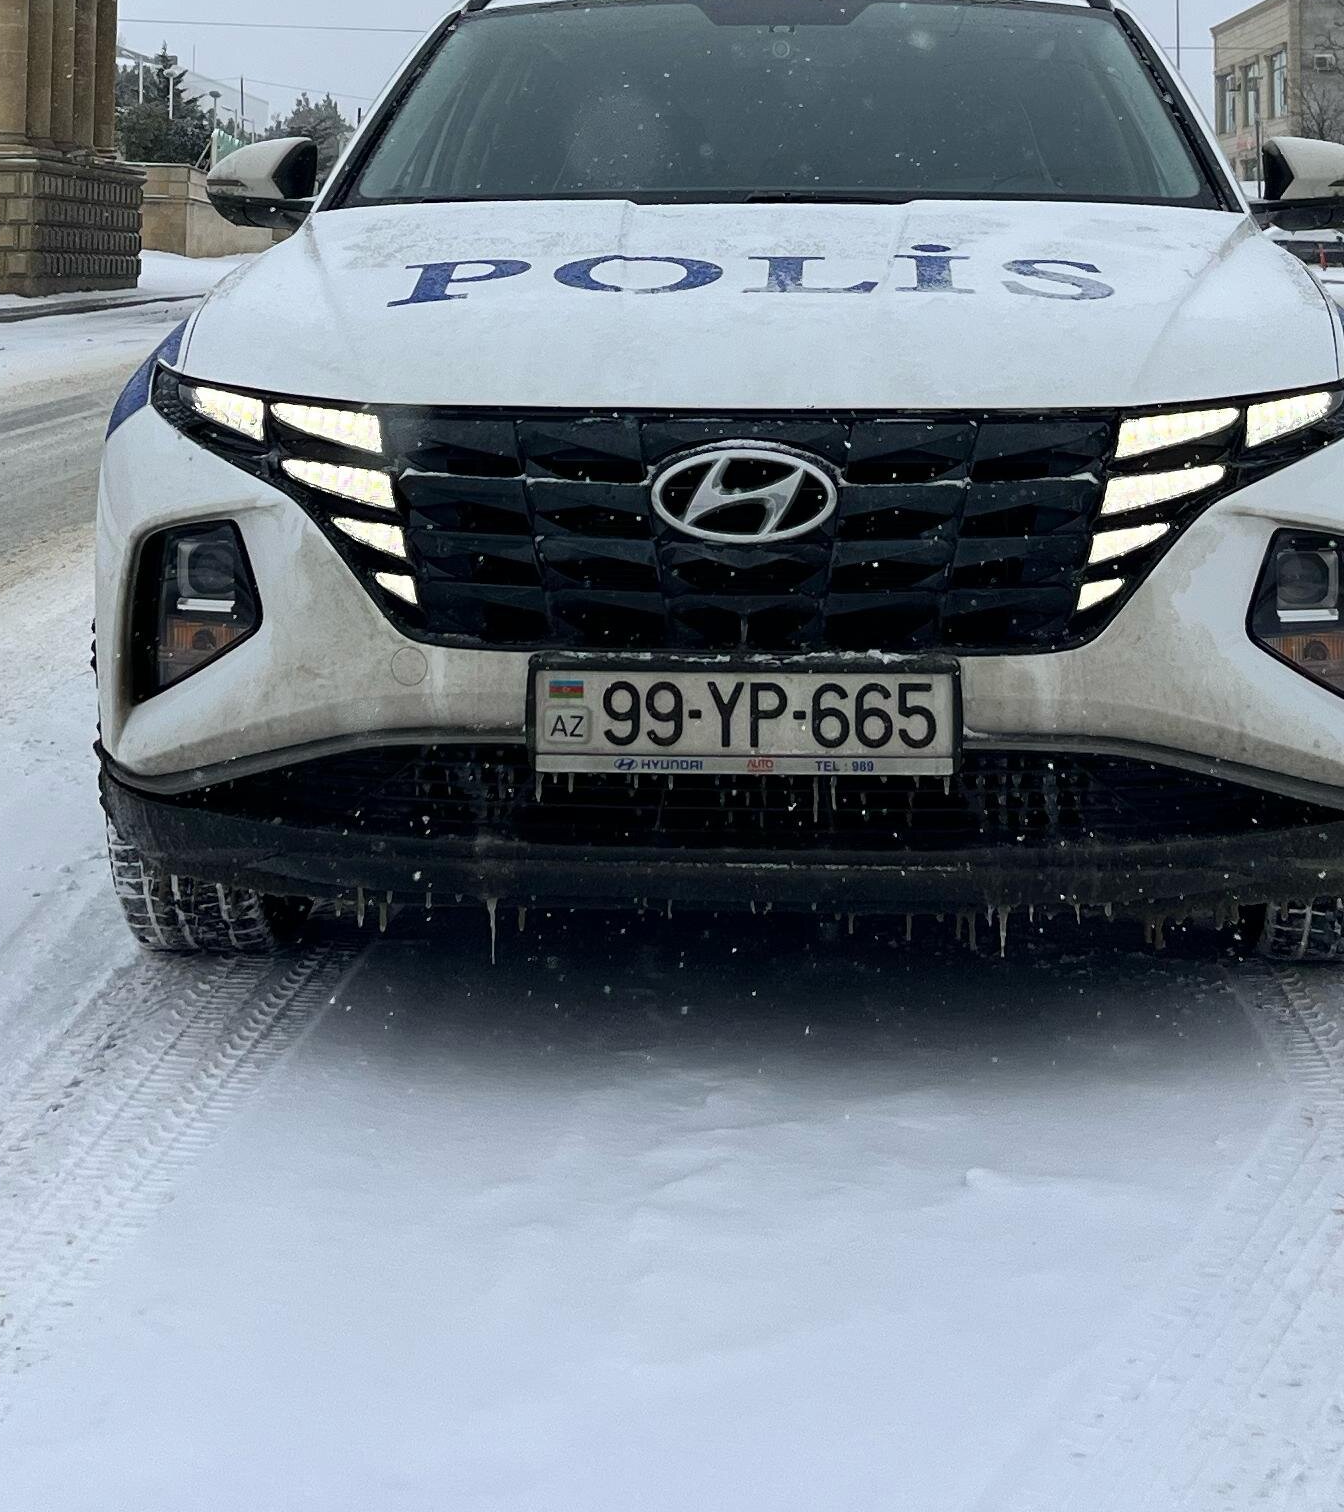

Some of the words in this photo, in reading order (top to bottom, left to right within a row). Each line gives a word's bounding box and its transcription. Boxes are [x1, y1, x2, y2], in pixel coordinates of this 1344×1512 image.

[387, 243, 1115, 307] POLİS
[550, 716, 584, 738] AZ
[602, 681, 937, 749] 99-YP-665
[640, 759, 704, 771] HYUNDAI
